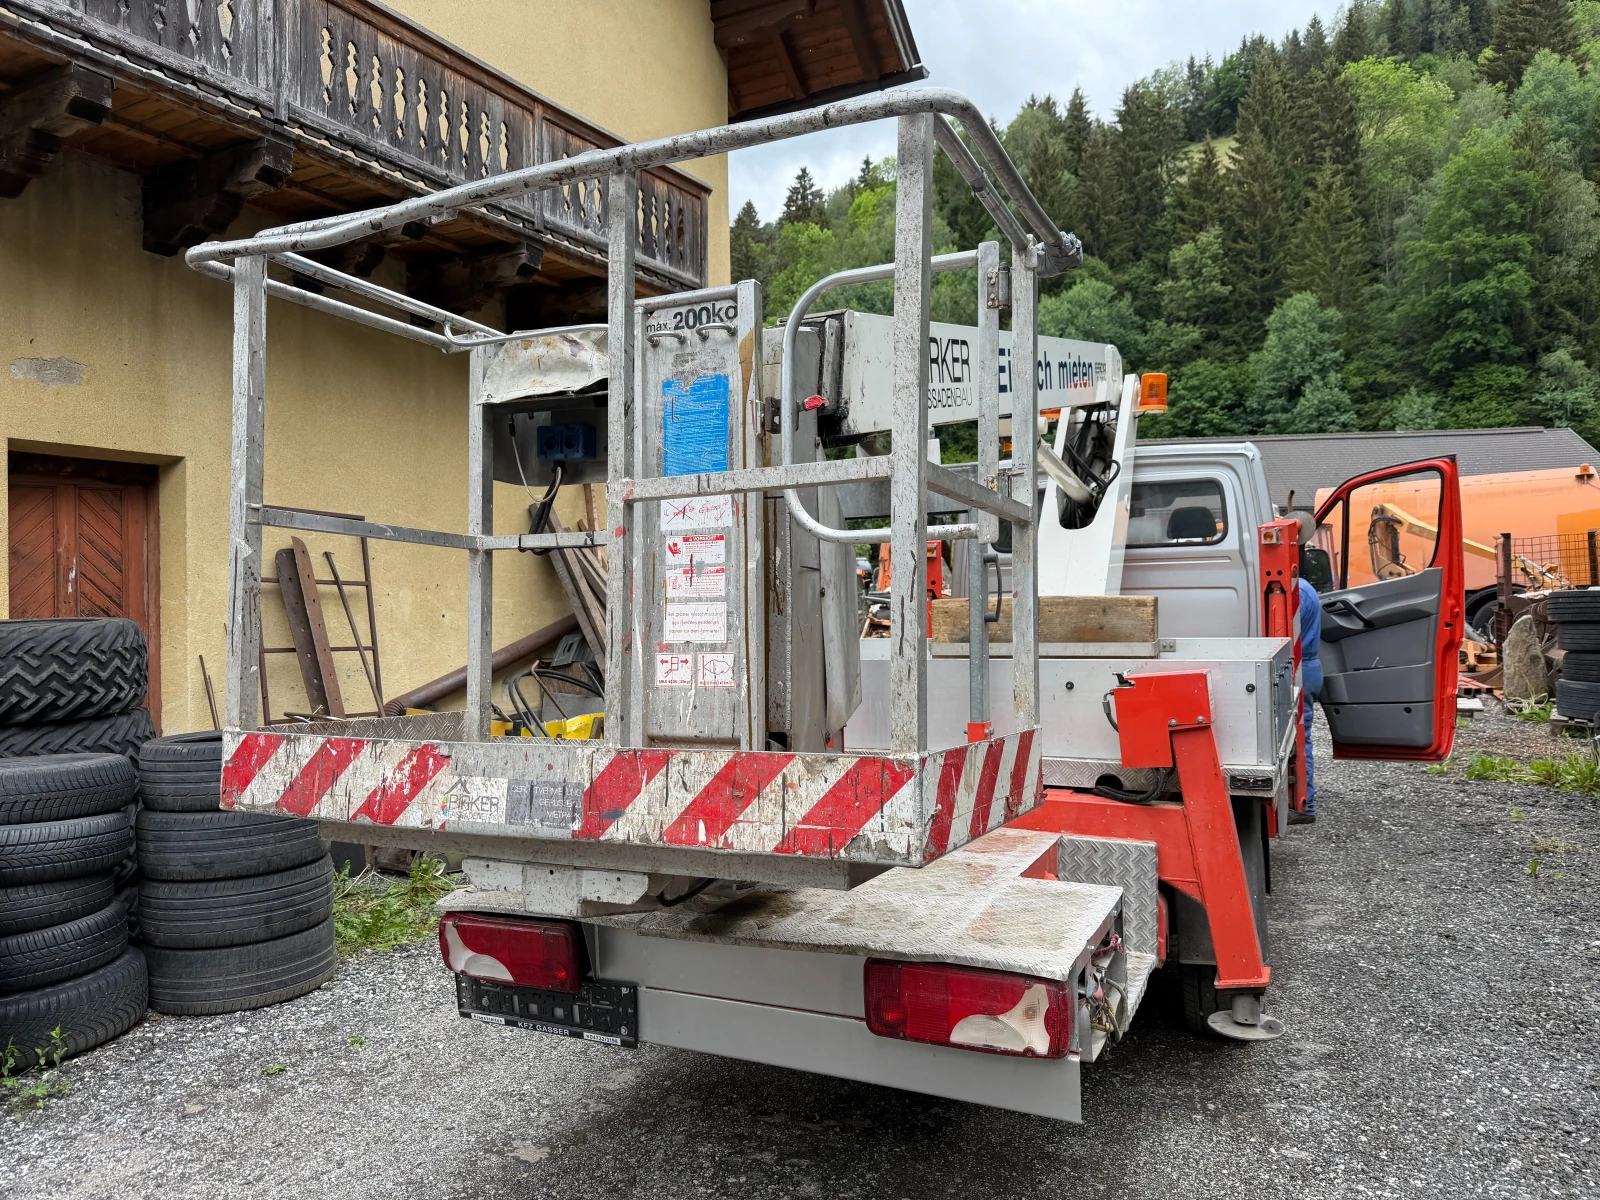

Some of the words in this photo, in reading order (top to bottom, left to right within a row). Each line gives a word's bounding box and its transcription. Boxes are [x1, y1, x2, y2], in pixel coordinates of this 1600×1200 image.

[646, 321, 671, 333] max.
[929, 336, 971, 384] RKER
[998, 347, 1053, 393] Eich
[1058, 351, 1094, 390] mieten
[927, 386, 973, 410] SSADENBAU
[448, 793, 500, 813] PIRKER
[517, 1021, 534, 1031] KFZ
[535, 1023, 570, 1036] GASSER
